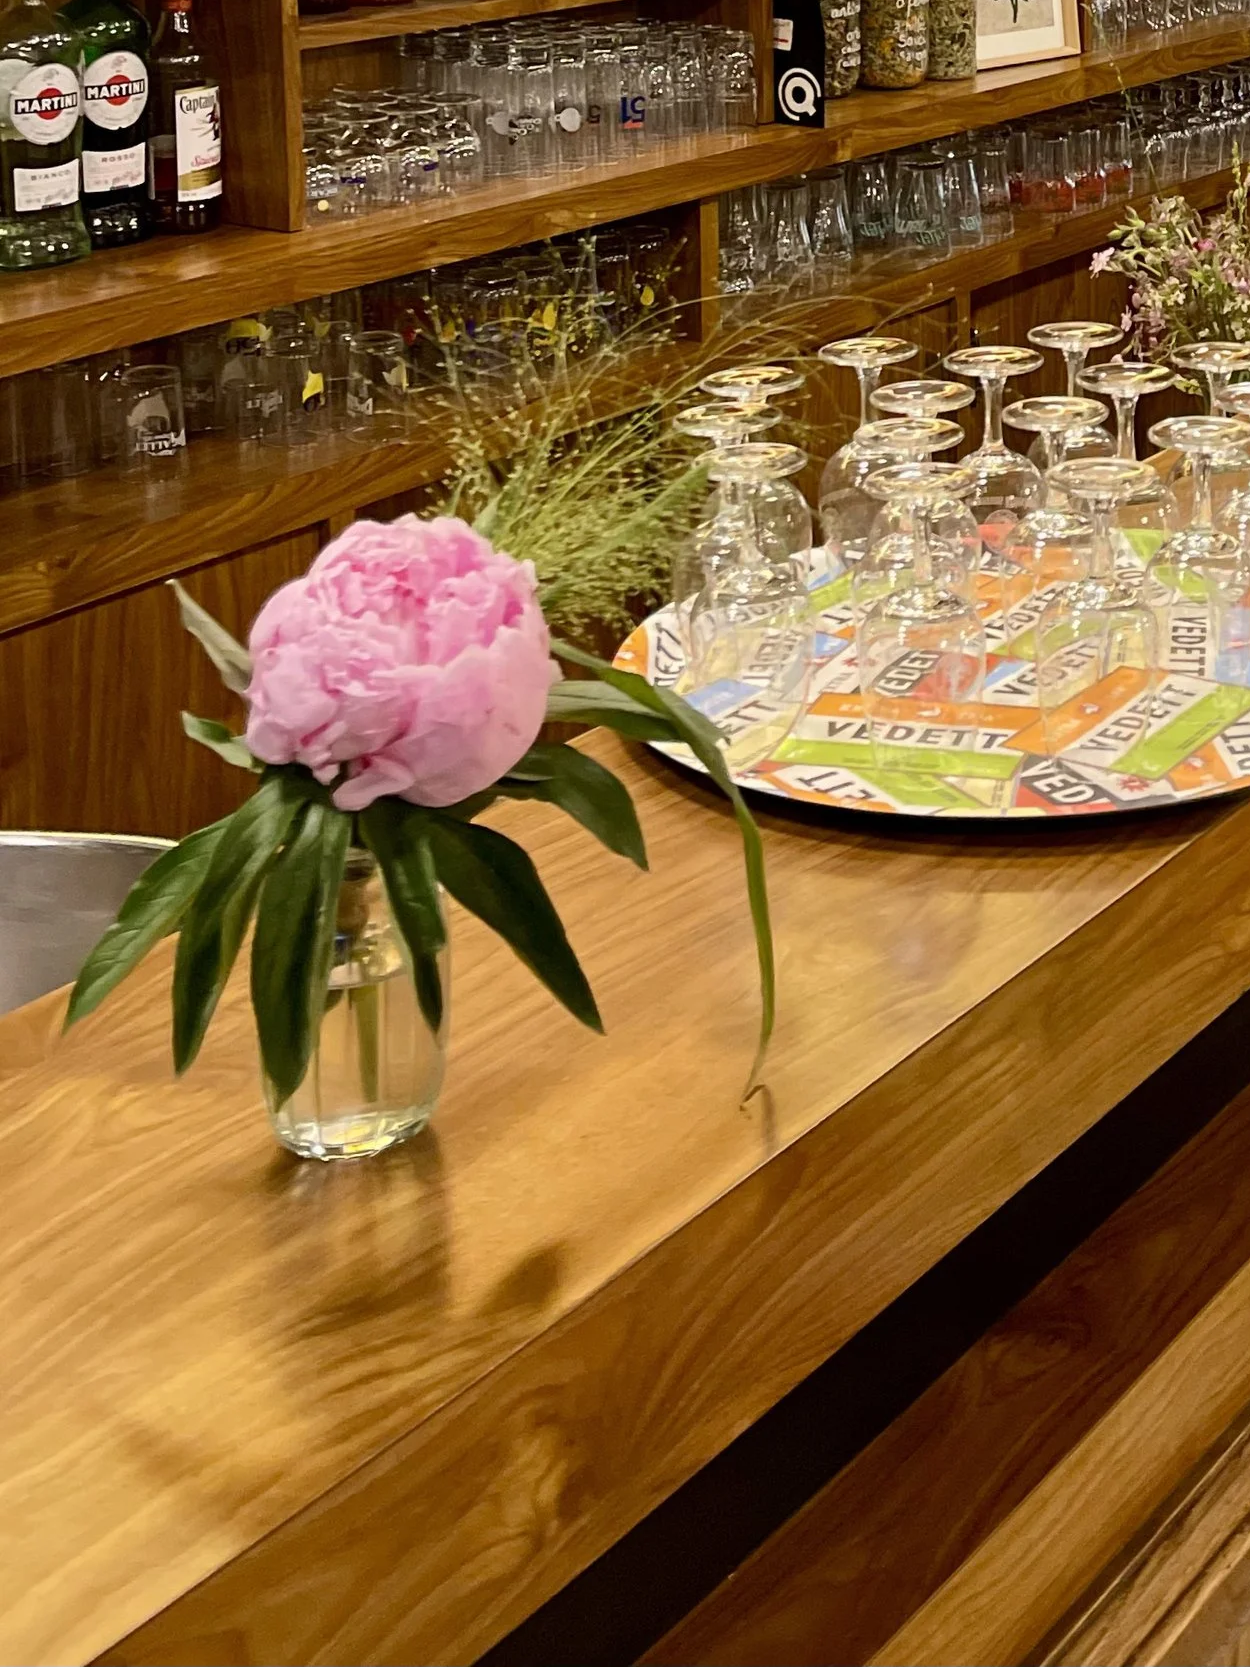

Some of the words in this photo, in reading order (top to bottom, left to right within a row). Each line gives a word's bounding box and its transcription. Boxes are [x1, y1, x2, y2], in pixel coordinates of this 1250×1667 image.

[86, 79, 145, 100] MARTINI
[16, 92, 78, 115] MARTINI
[100, 151, 136, 164] ROSSO
[30, 168, 72, 182] BIANCO
[826, 720, 1010, 751] VEDETT
